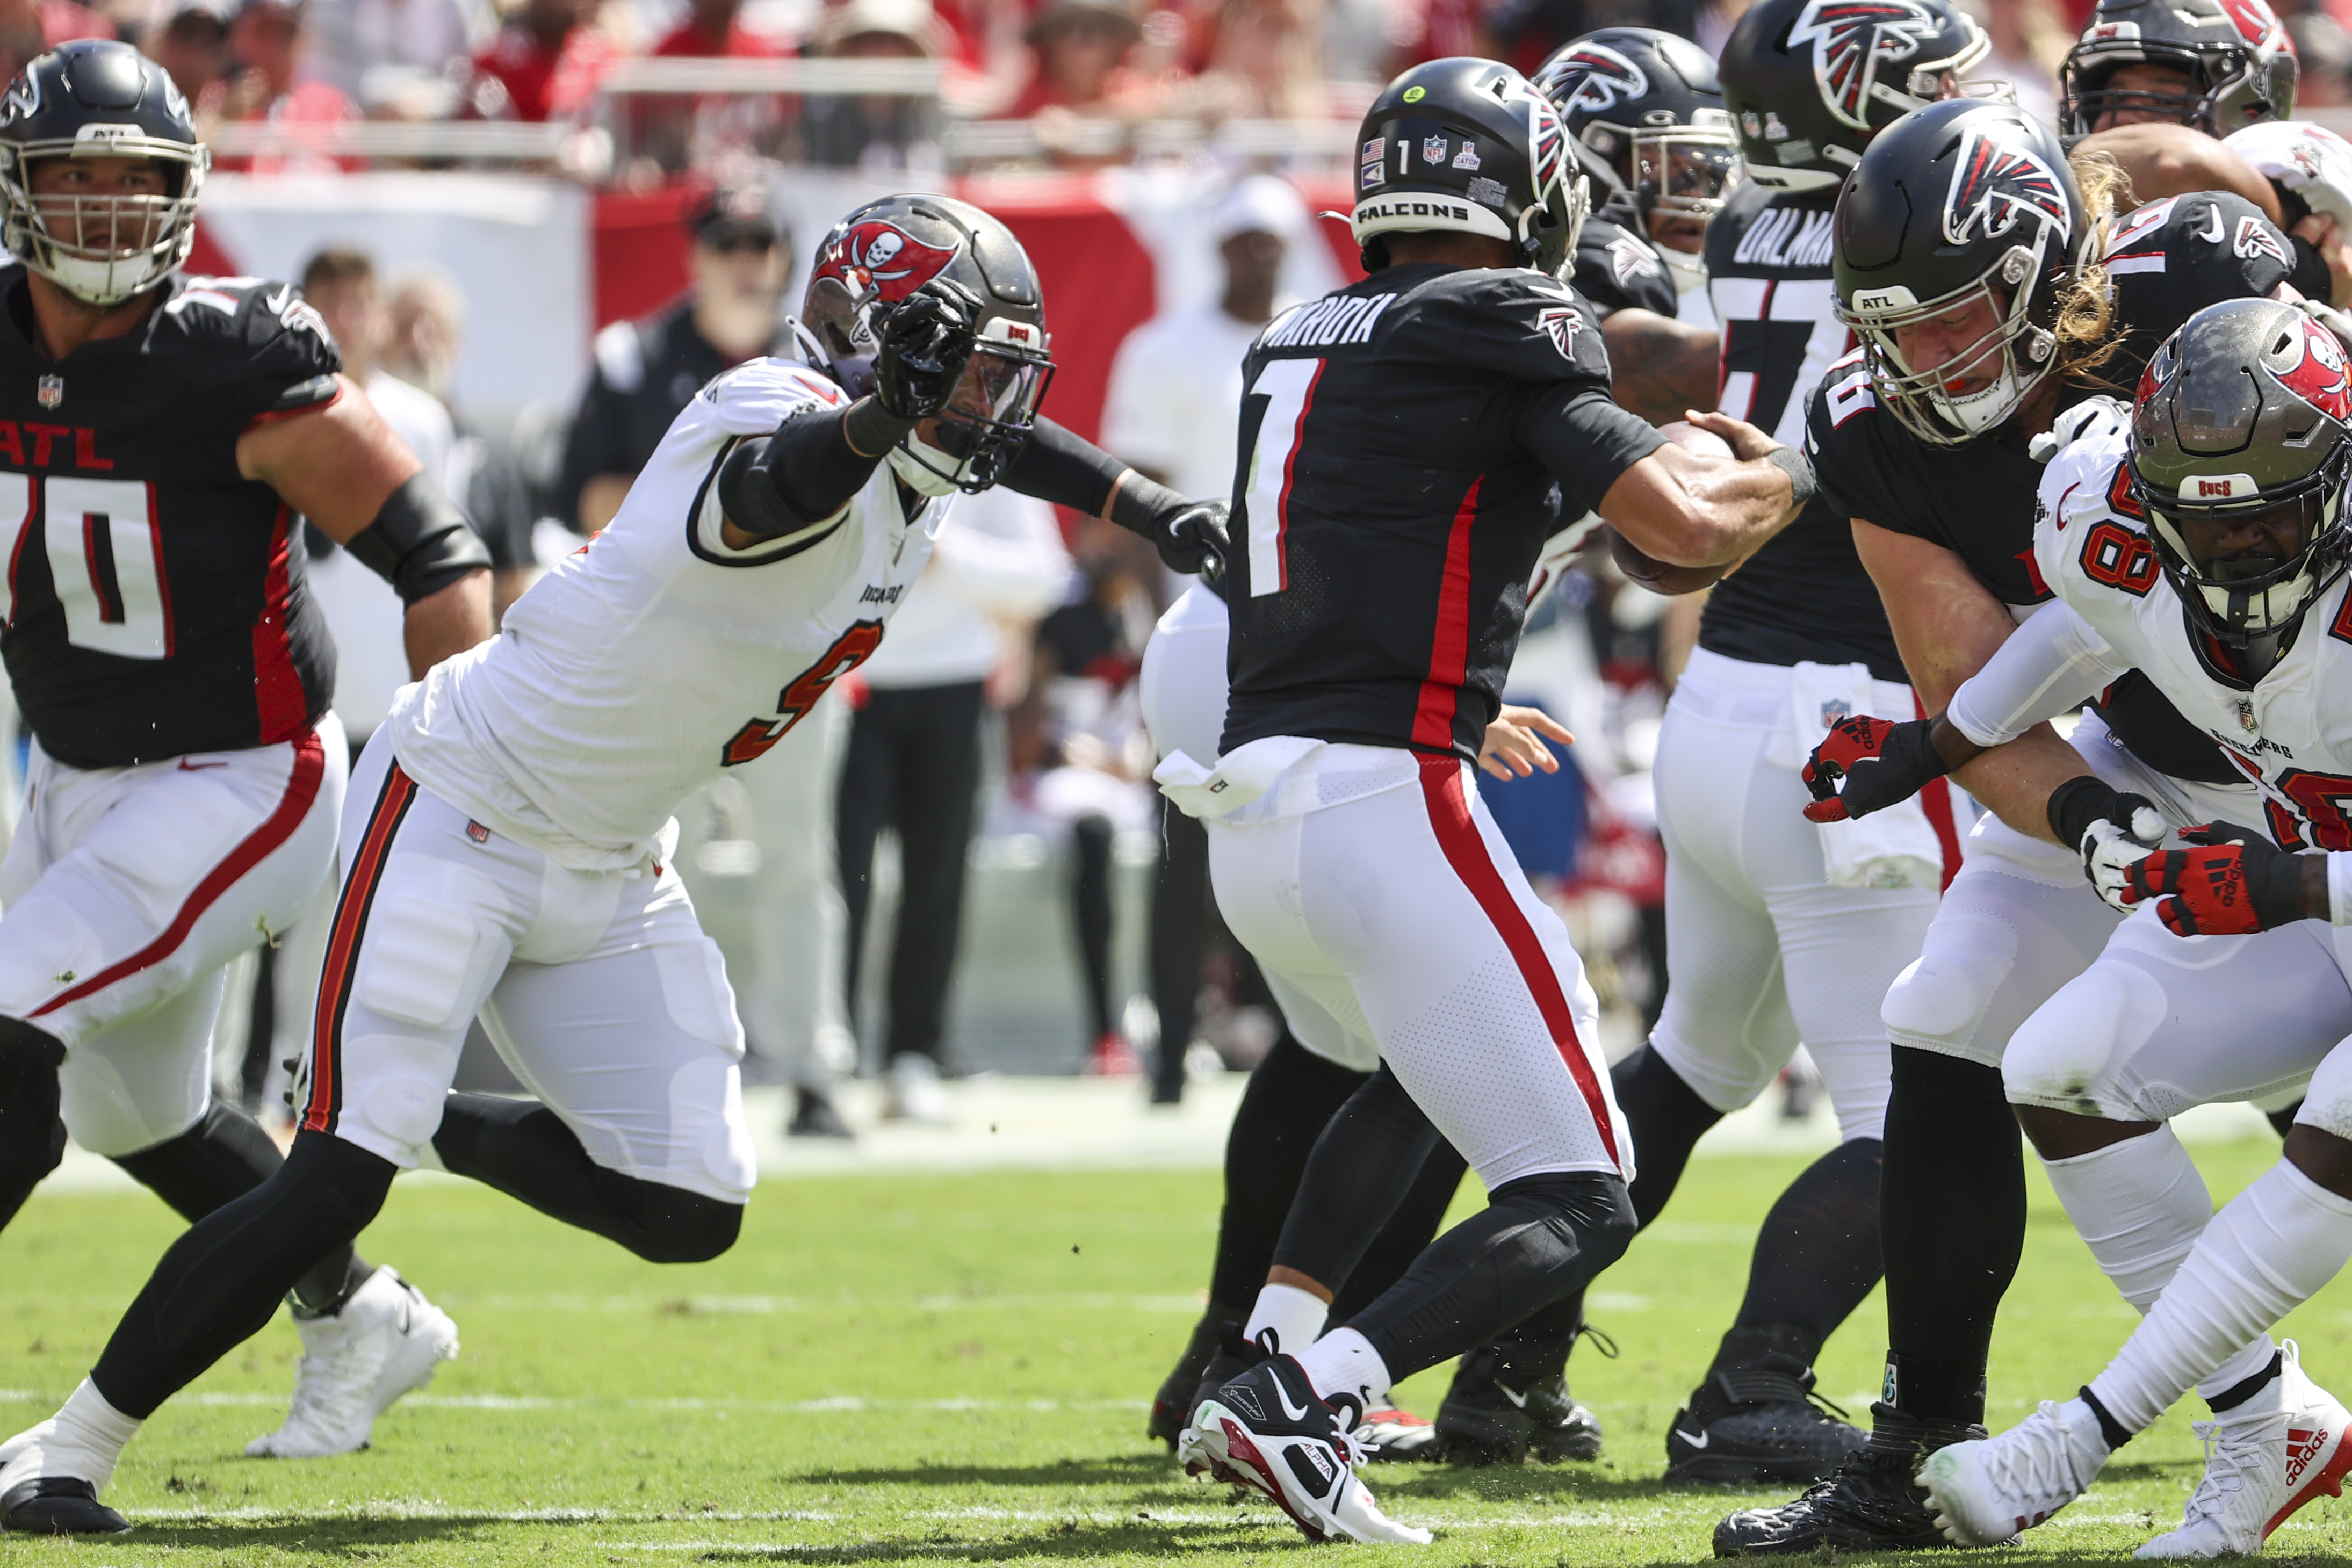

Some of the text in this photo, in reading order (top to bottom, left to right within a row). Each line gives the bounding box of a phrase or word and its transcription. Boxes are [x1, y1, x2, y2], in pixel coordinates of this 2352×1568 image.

[1398, 140, 1410, 175] 1
[1426, 148, 1442, 160] NFL
[1454, 156, 1478, 165] CATCH
[1357, 203, 1469, 223] FALCONS
[1862, 295, 1894, 310] ATL
[1256, 293, 1397, 350] MARIOTA
[1245, 357, 1326, 598] 1
[2198, 480, 2231, 497] BUCS
[720, 617, 884, 767] 9
[2241, 713, 2255, 729] NFL
[2222, 859, 2244, 907] adida
[1299, 1441, 1331, 1478] ALPHA
[2286, 1428, 2329, 1486] adidas
